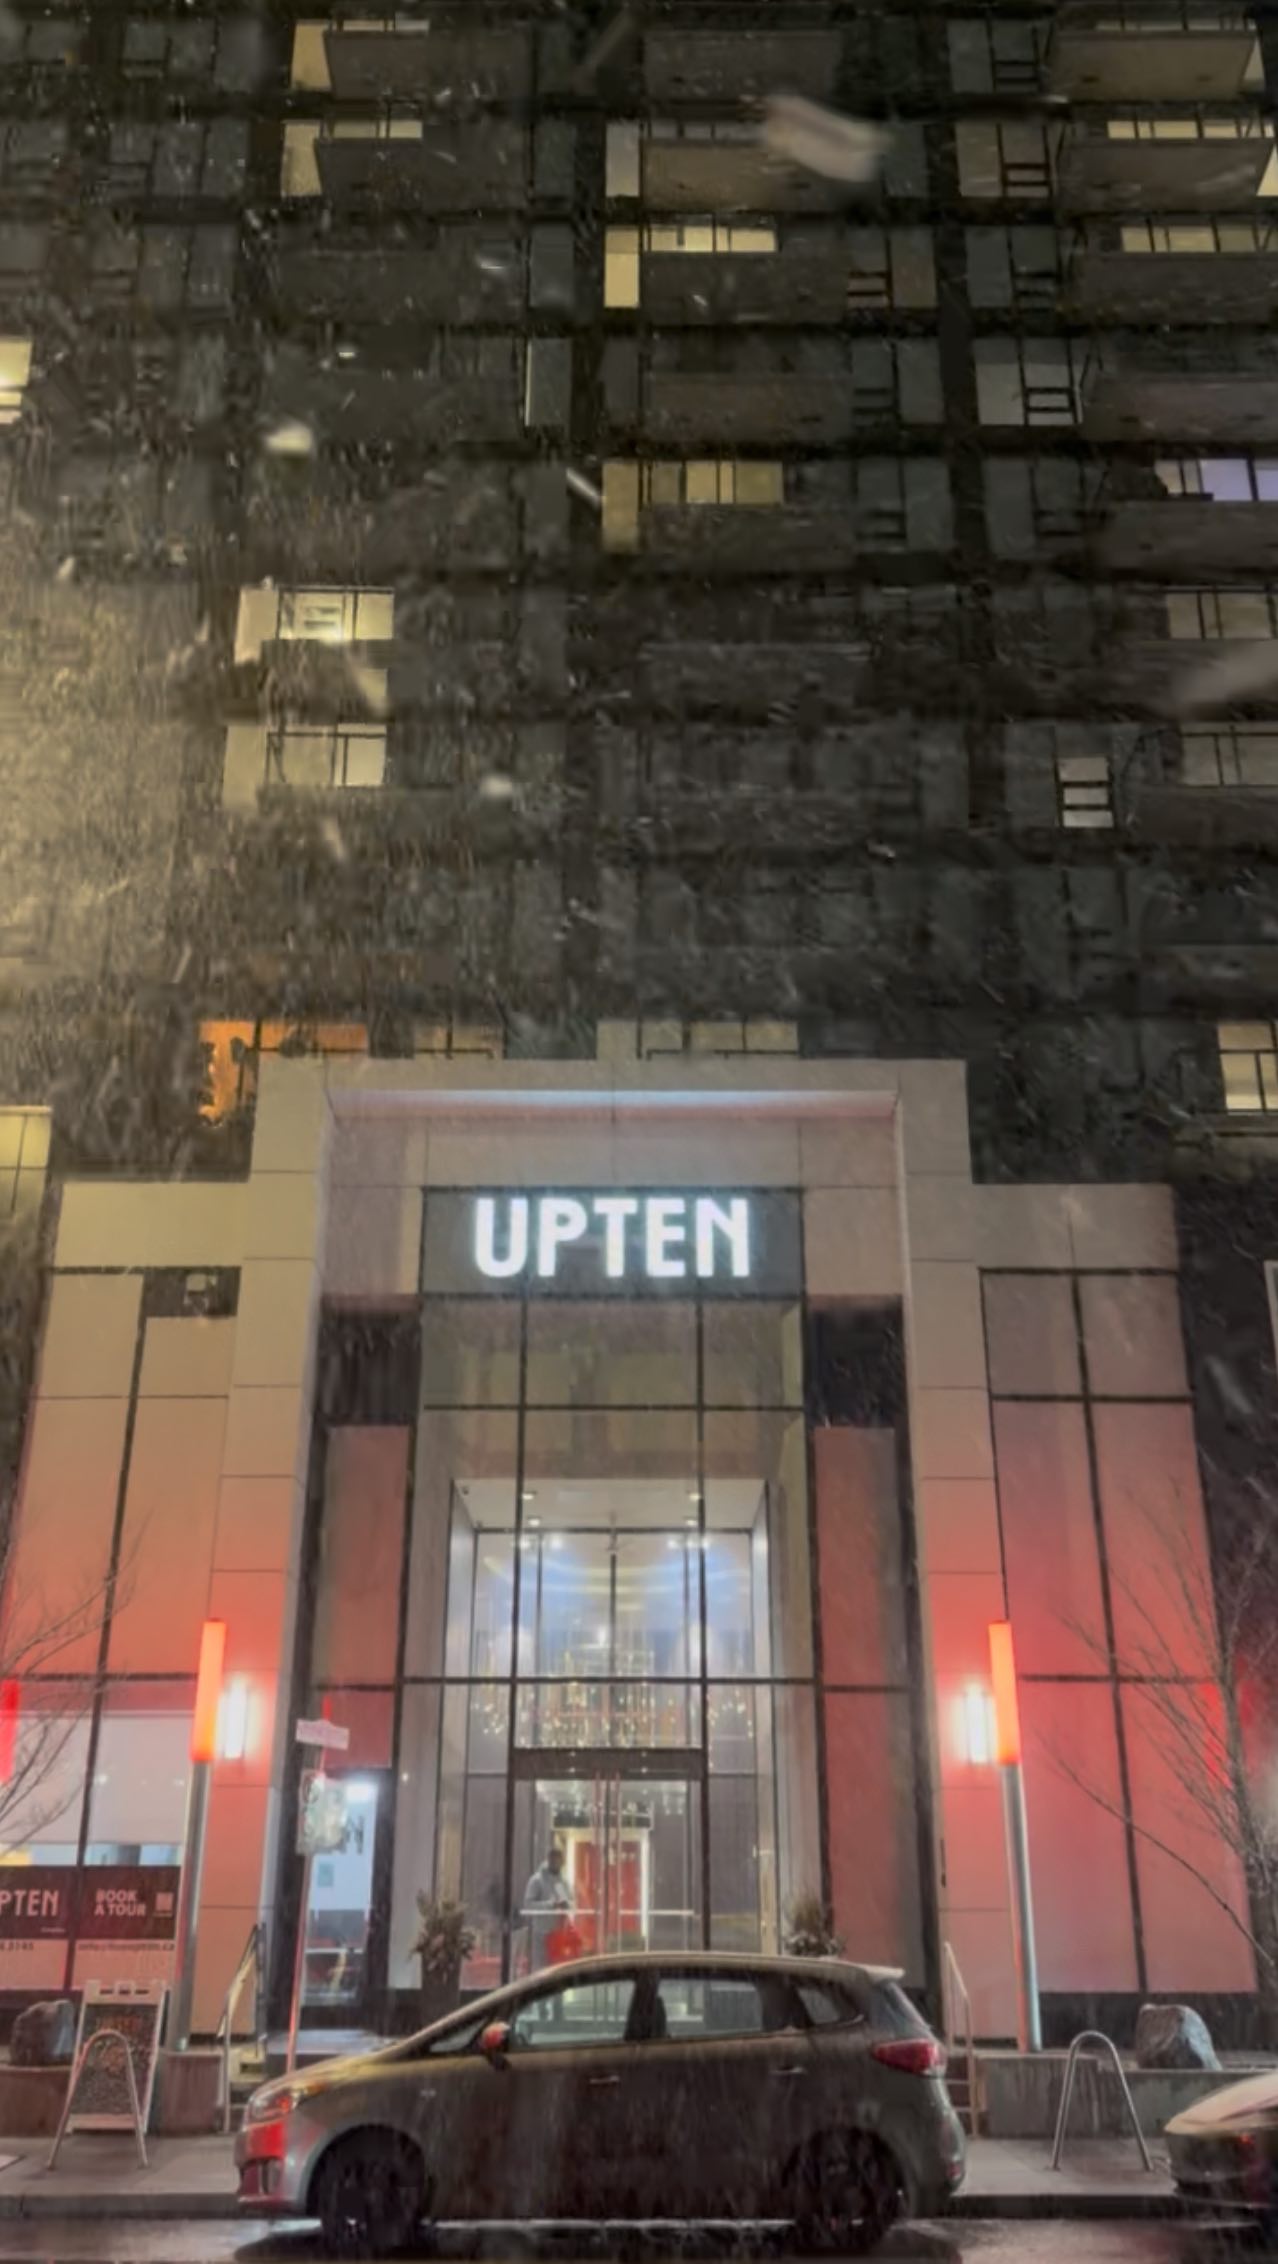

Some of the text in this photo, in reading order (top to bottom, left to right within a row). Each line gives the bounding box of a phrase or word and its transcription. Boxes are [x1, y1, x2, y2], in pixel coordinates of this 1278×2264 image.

[474, 1196, 750, 1278] UPTEN
[96, 1889, 138, 1903] BOOK
[94, 1903, 146, 1917] A TOUR
